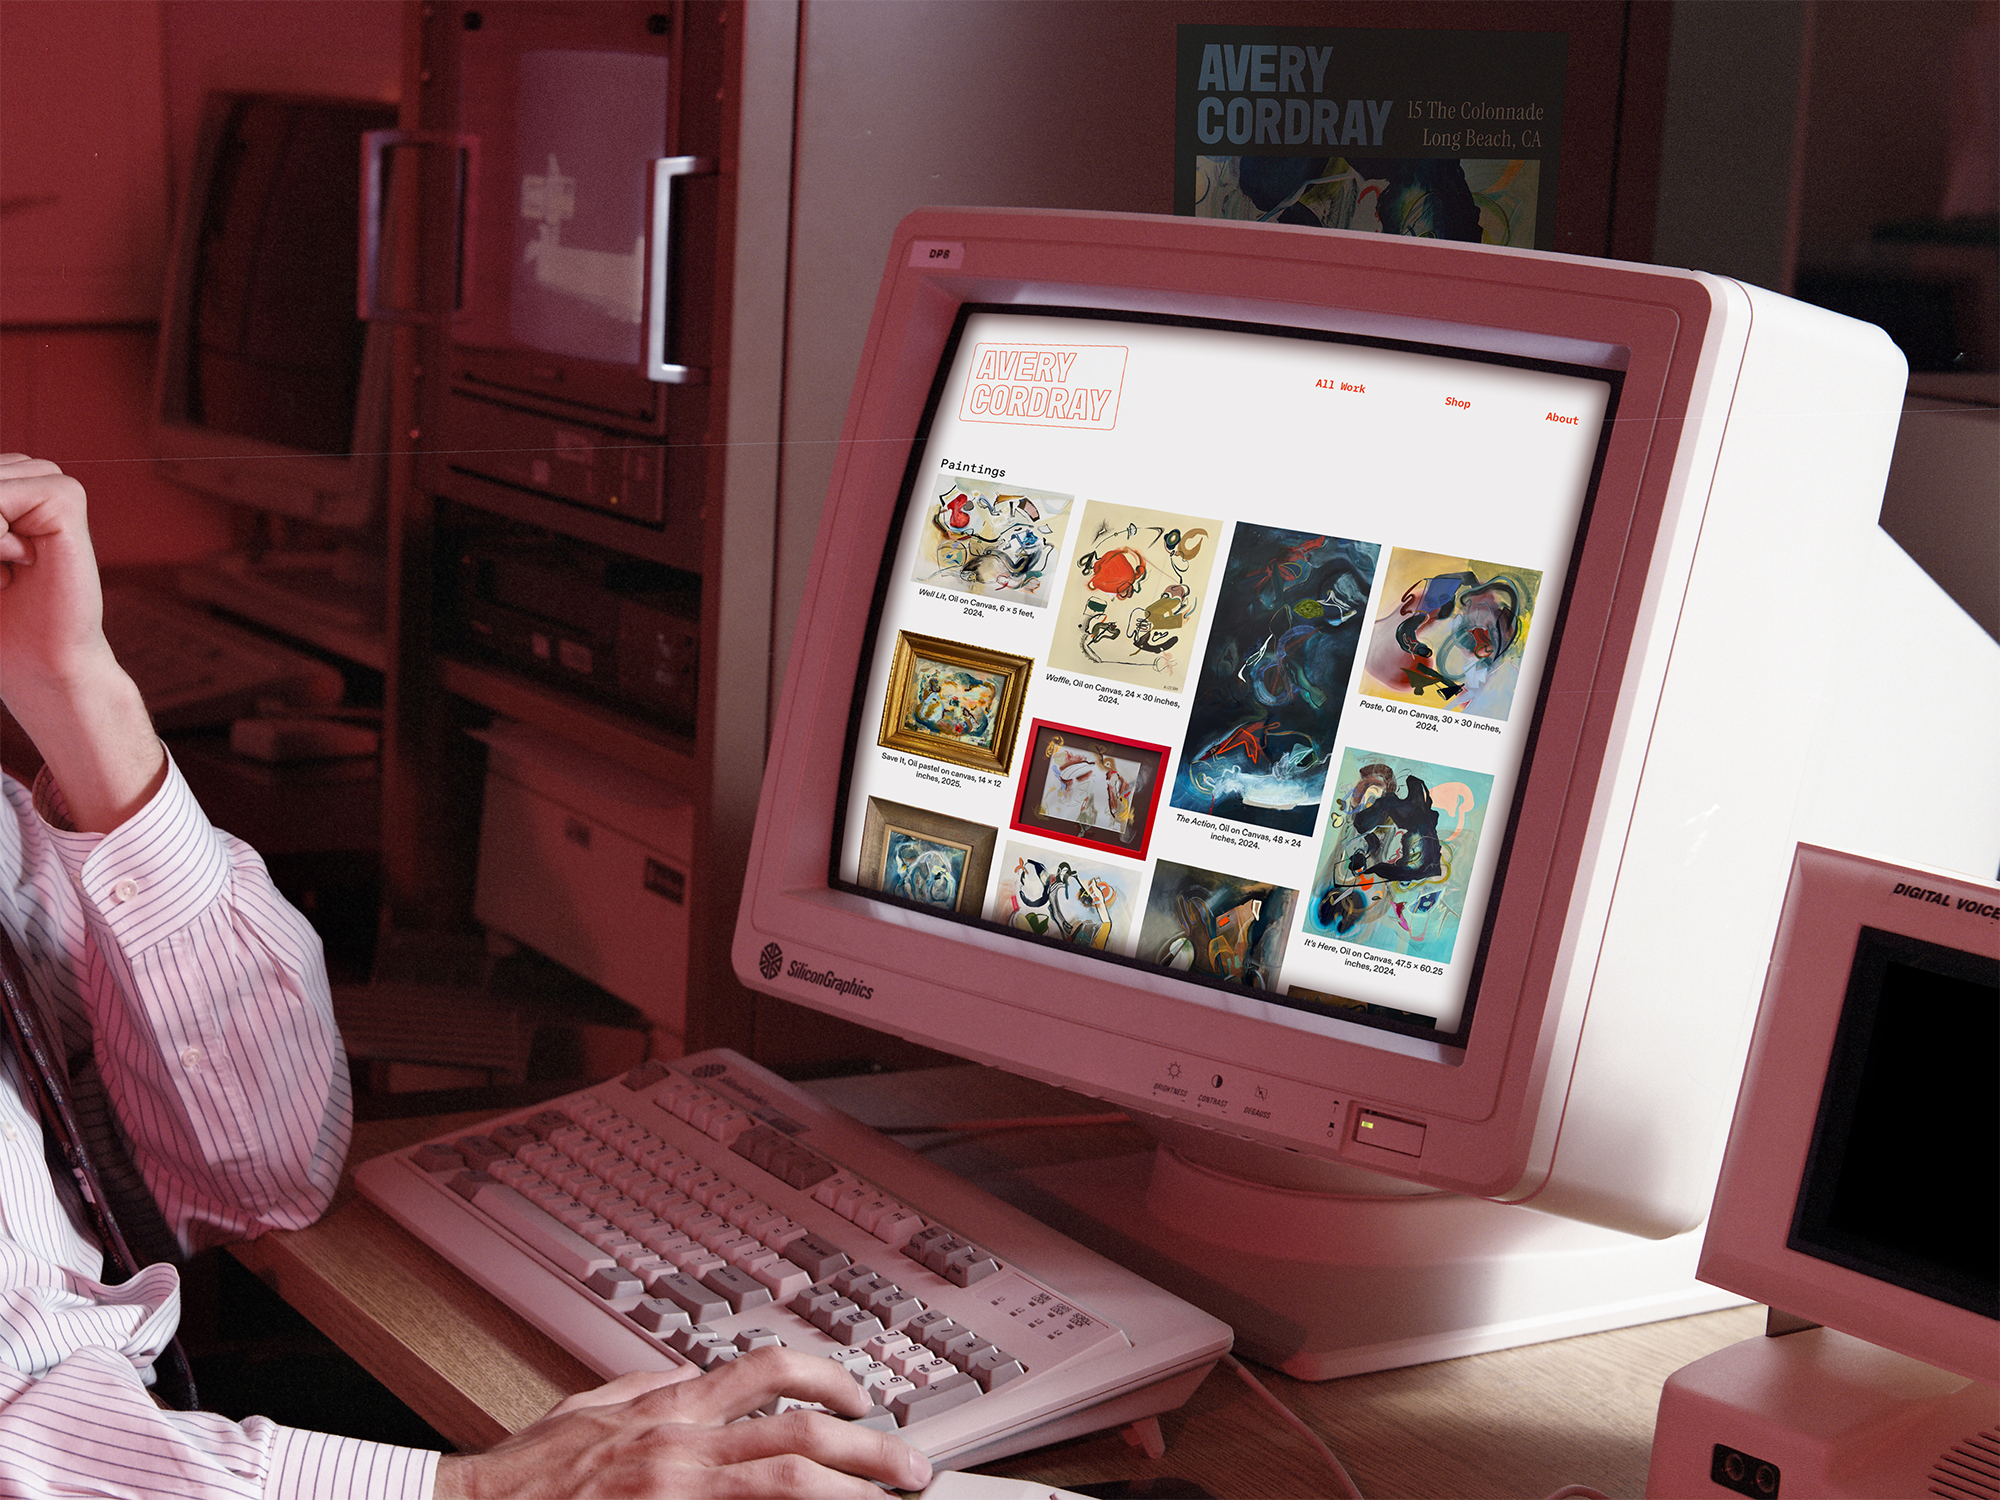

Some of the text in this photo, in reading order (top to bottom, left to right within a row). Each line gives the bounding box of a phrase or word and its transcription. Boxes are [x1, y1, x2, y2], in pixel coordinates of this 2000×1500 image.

[1198, 44, 1334, 92] AVERY
[1407, 100, 1544, 121] 15 The Colonnade
[1197, 97, 1393, 146] CORDRAY
[1423, 128, 1542, 150] Long Beach, CA
[976, 350, 1078, 382] AVERY
[1315, 379, 1366, 394] All Work
[970, 384, 1112, 421] CORDRAY
[1444, 396, 1471, 410] Shop
[1545, 412, 1580, 426] About
[940, 458, 1006, 478] Paintings
[919, 588, 936, 599] Well
[936, 592, 948, 602] Lit,
[948, 594, 959, 603] Oil
[970, 599, 998, 612] Canvas,
[1018, 608, 1035, 620] feet,
[963, 607, 984, 618] 2024.
[1046, 673, 1072, 686] Waffle,
[1072, 679, 1084, 688] Oil
[1095, 684, 1124, 697] Canvas,
[1125, 690, 1136, 698] 24
[1142, 694, 1154, 702] 30
[1154, 696, 1180, 708] inches,
[1098, 694, 1120, 706] 2024.
[1360, 700, 1384, 713] Paste,
[1386, 704, 1397, 714] Oil
[1410, 710, 1440, 723] Canvas,
[1442, 716, 1453, 724] 30
[1461, 719, 1472, 728] 30
[1473, 721, 1502, 734] inches,
[1416, 721, 1438, 732] 2024.
[882, 752, 899, 763] Save
[899, 756, 907, 766] It,
[908, 758, 918, 768] Oil
[918, 761, 940, 774] pastel
[950, 769, 977, 783] canvas,
[978, 776, 986, 784] 14
[993, 780, 1002, 788] 12
[916, 771, 962, 788] inches, 2025.
[1176, 814, 1190, 824] The
[1190, 817, 1218, 830] Action,
[1219, 824, 1230, 832] Oil
[1230, 827, 1240, 835] on
[1242, 828, 1271, 842] Canvas,
[1272, 836, 1284, 844] 48
[1290, 838, 1302, 848] 24
[1210, 832, 1260, 850] inches, 2024.
[1892, 882, 2000, 920] DIGITAL VOICE
[1317, 942, 1338, 954] Here,
[1340, 946, 1351, 956] Oil
[1363, 952, 1394, 966] Canvas,
[1396, 959, 1412, 970] 47.5
[1420, 964, 1444, 976] 60.25
[1344, 958, 1396, 976] inches, 2024.
[786, 960, 874, 1000] SiliconGraphics
[1153, 1082, 1188, 1098] BRIGHTNESS
[1197, 1094, 1228, 1108] CONTRAST
[1243, 1106, 1272, 1120] DEGAUSS
